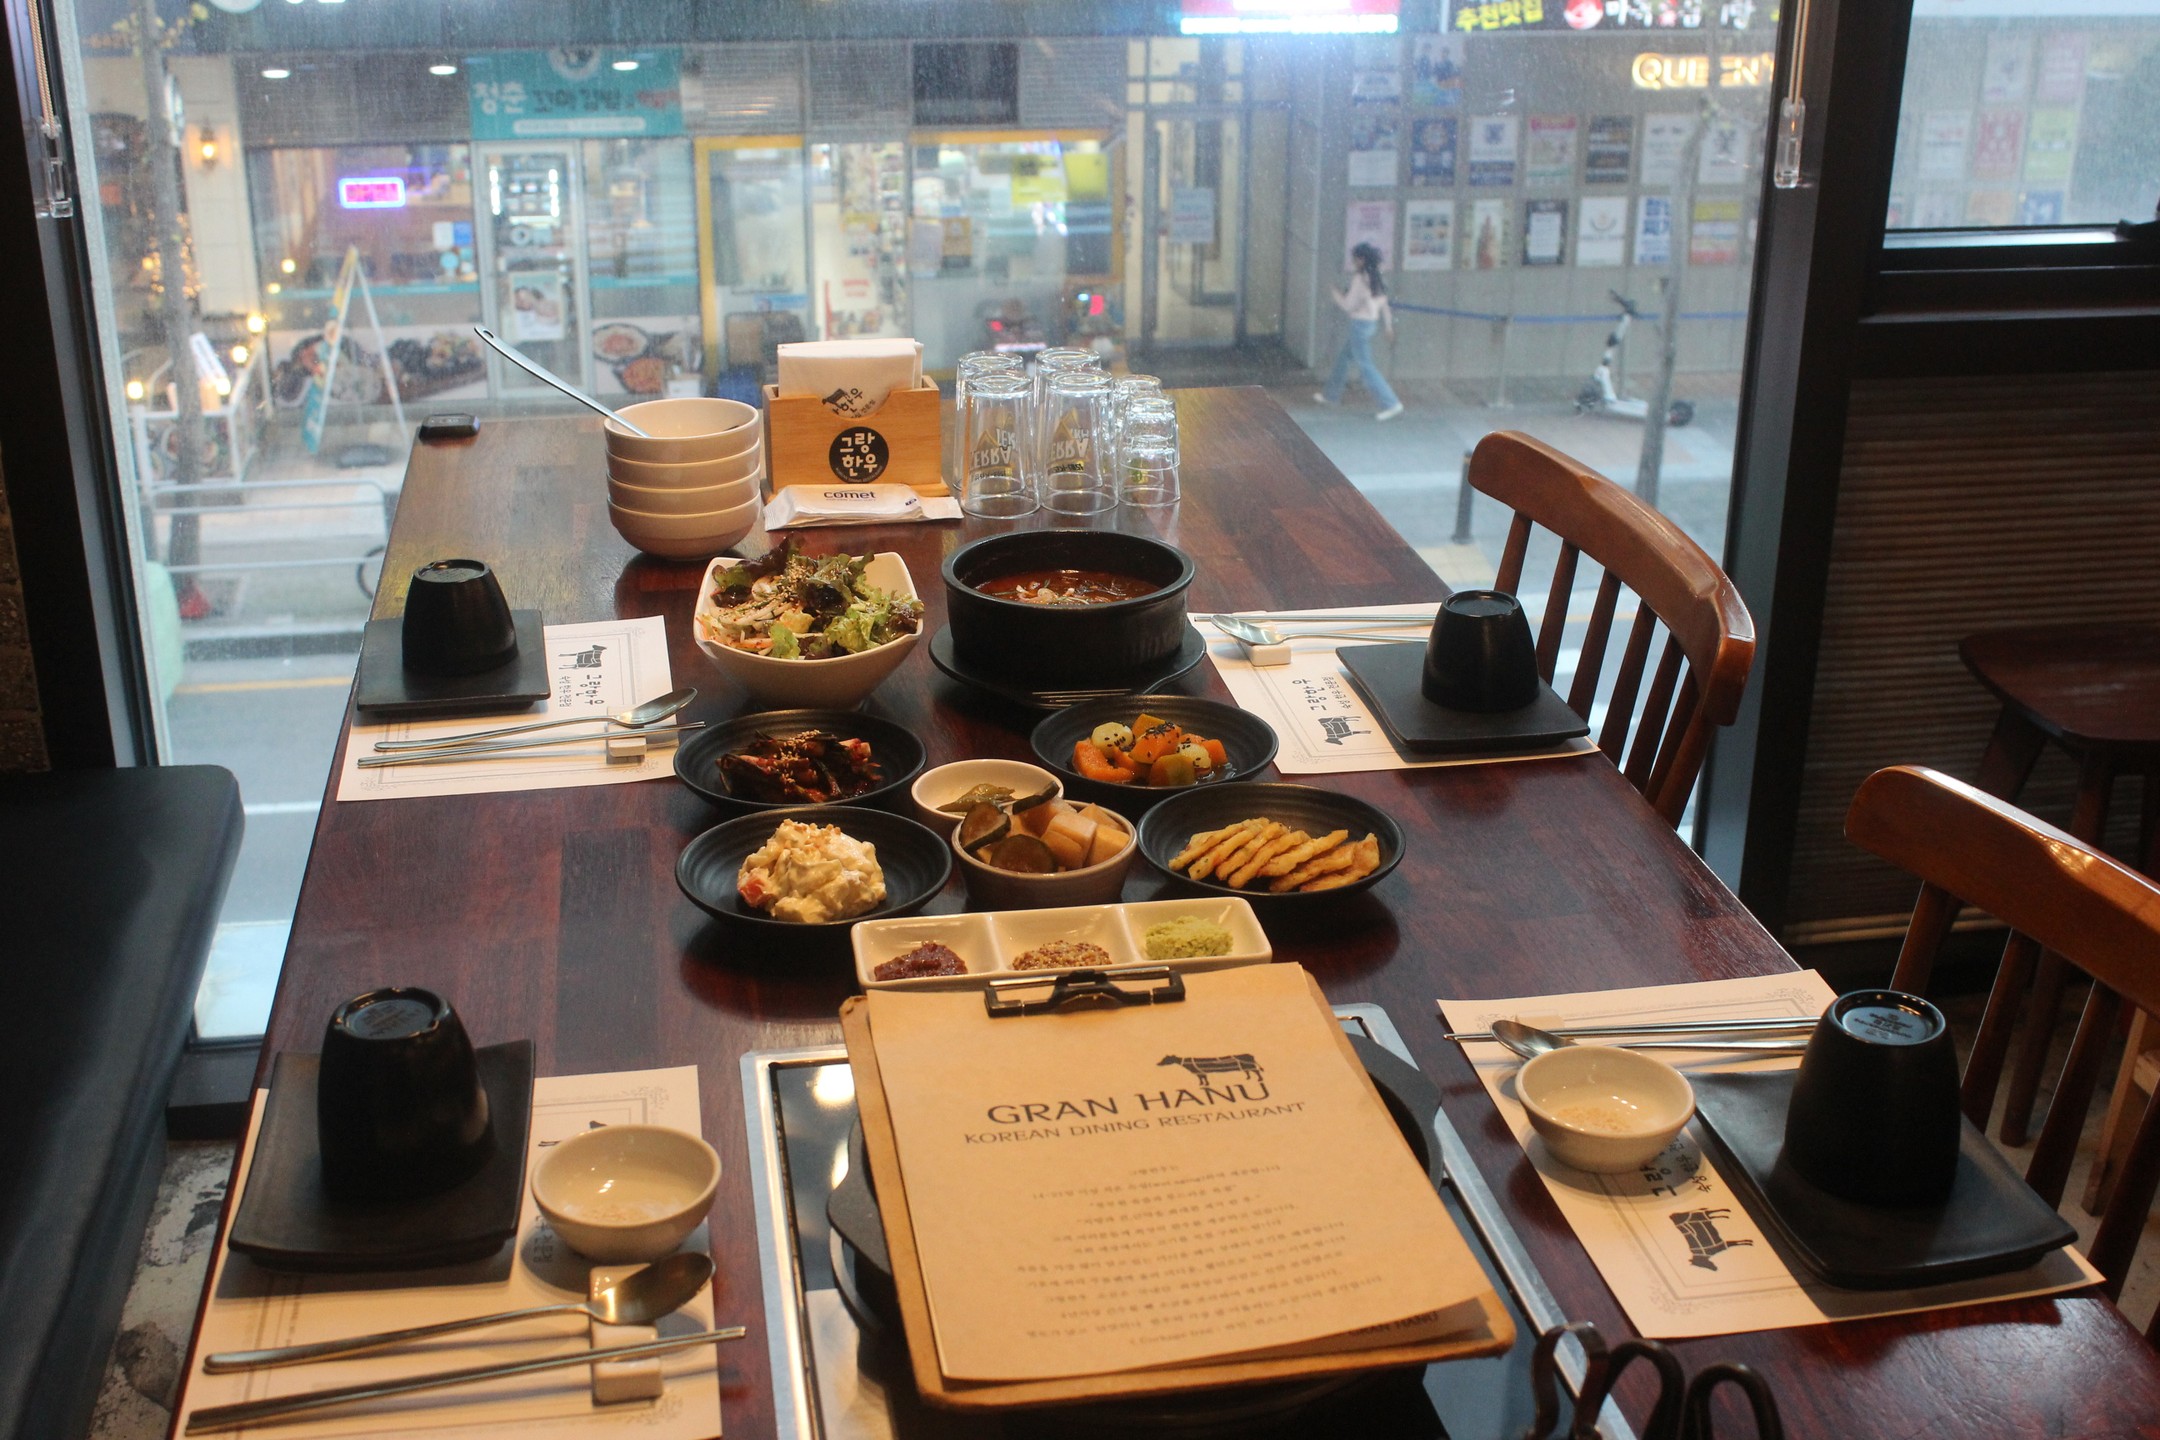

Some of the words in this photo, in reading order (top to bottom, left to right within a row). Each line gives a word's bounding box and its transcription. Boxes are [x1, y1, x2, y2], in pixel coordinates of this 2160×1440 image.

[839, 432, 876, 454] 그랑
[841, 454, 878, 477] 한우
[823, 490, 877, 500] comet
[576, 674, 605, 706] 그랑한우
[1292, 679, 1327, 711] 그랑한우
[987, 1096, 1120, 1125] GRAN
[1134, 1081, 1271, 1112] HANU
[963, 1127, 1062, 1145] KOREAN
[1069, 1118, 1151, 1138] DINING
[1157, 1101, 1306, 1129] RESTAURANT
